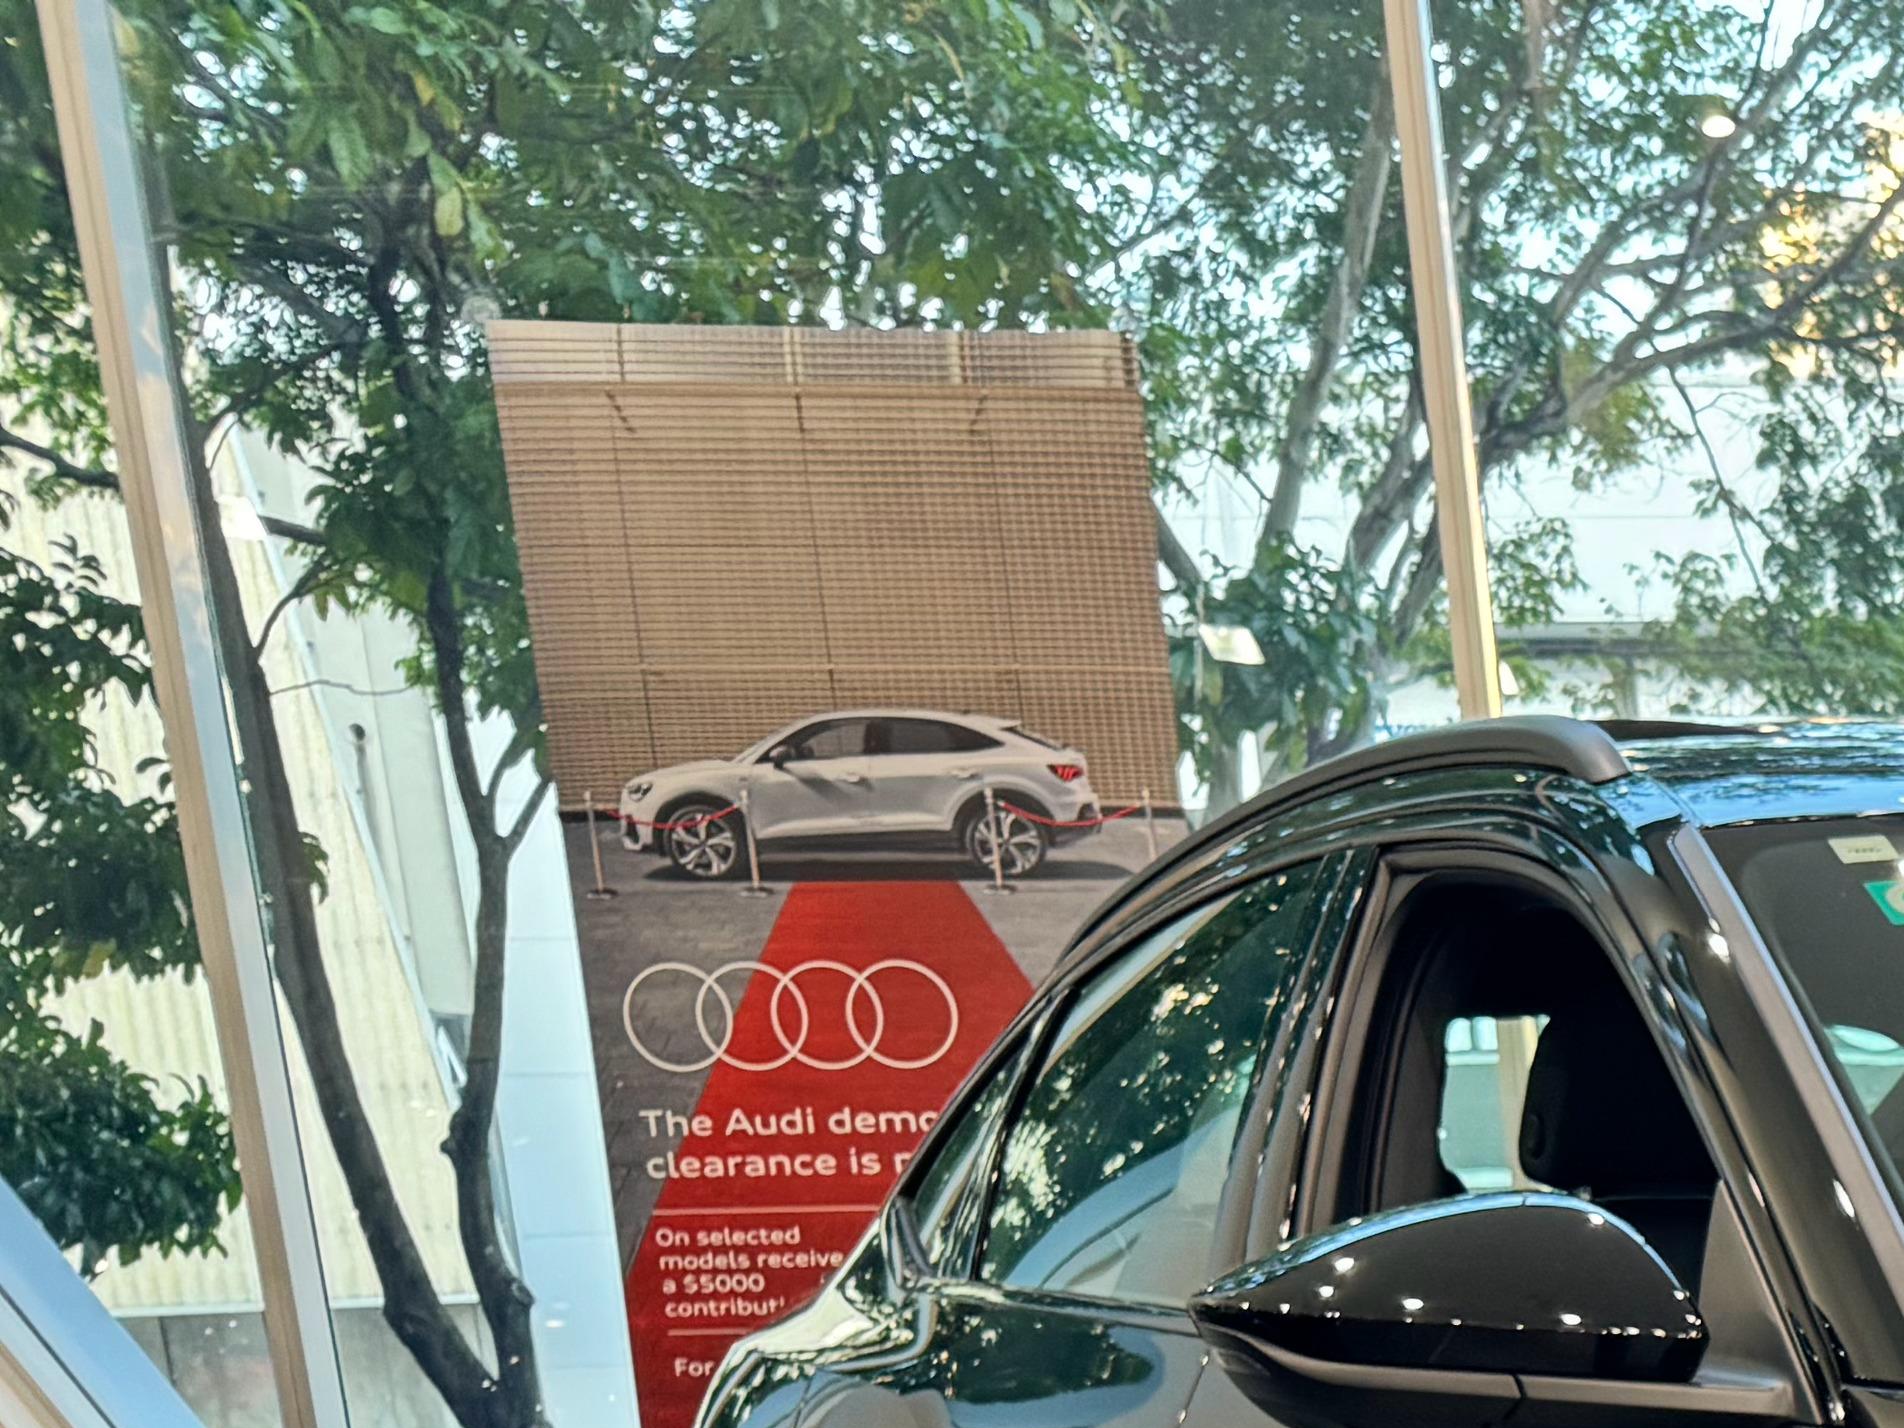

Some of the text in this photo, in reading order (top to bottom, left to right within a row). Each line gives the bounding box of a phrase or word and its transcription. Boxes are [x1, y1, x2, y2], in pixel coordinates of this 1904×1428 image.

[638, 1109, 713, 1137] The
[725, 1107, 816, 1136] Audi
[646, 1152, 837, 1179] clearance
[849, 1147, 881, 1175] is
[655, 1226, 801, 1247] On selected
[659, 1249, 844, 1271] models receive
[662, 1273, 766, 1295] a $5000
[674, 1357, 715, 1377] For
